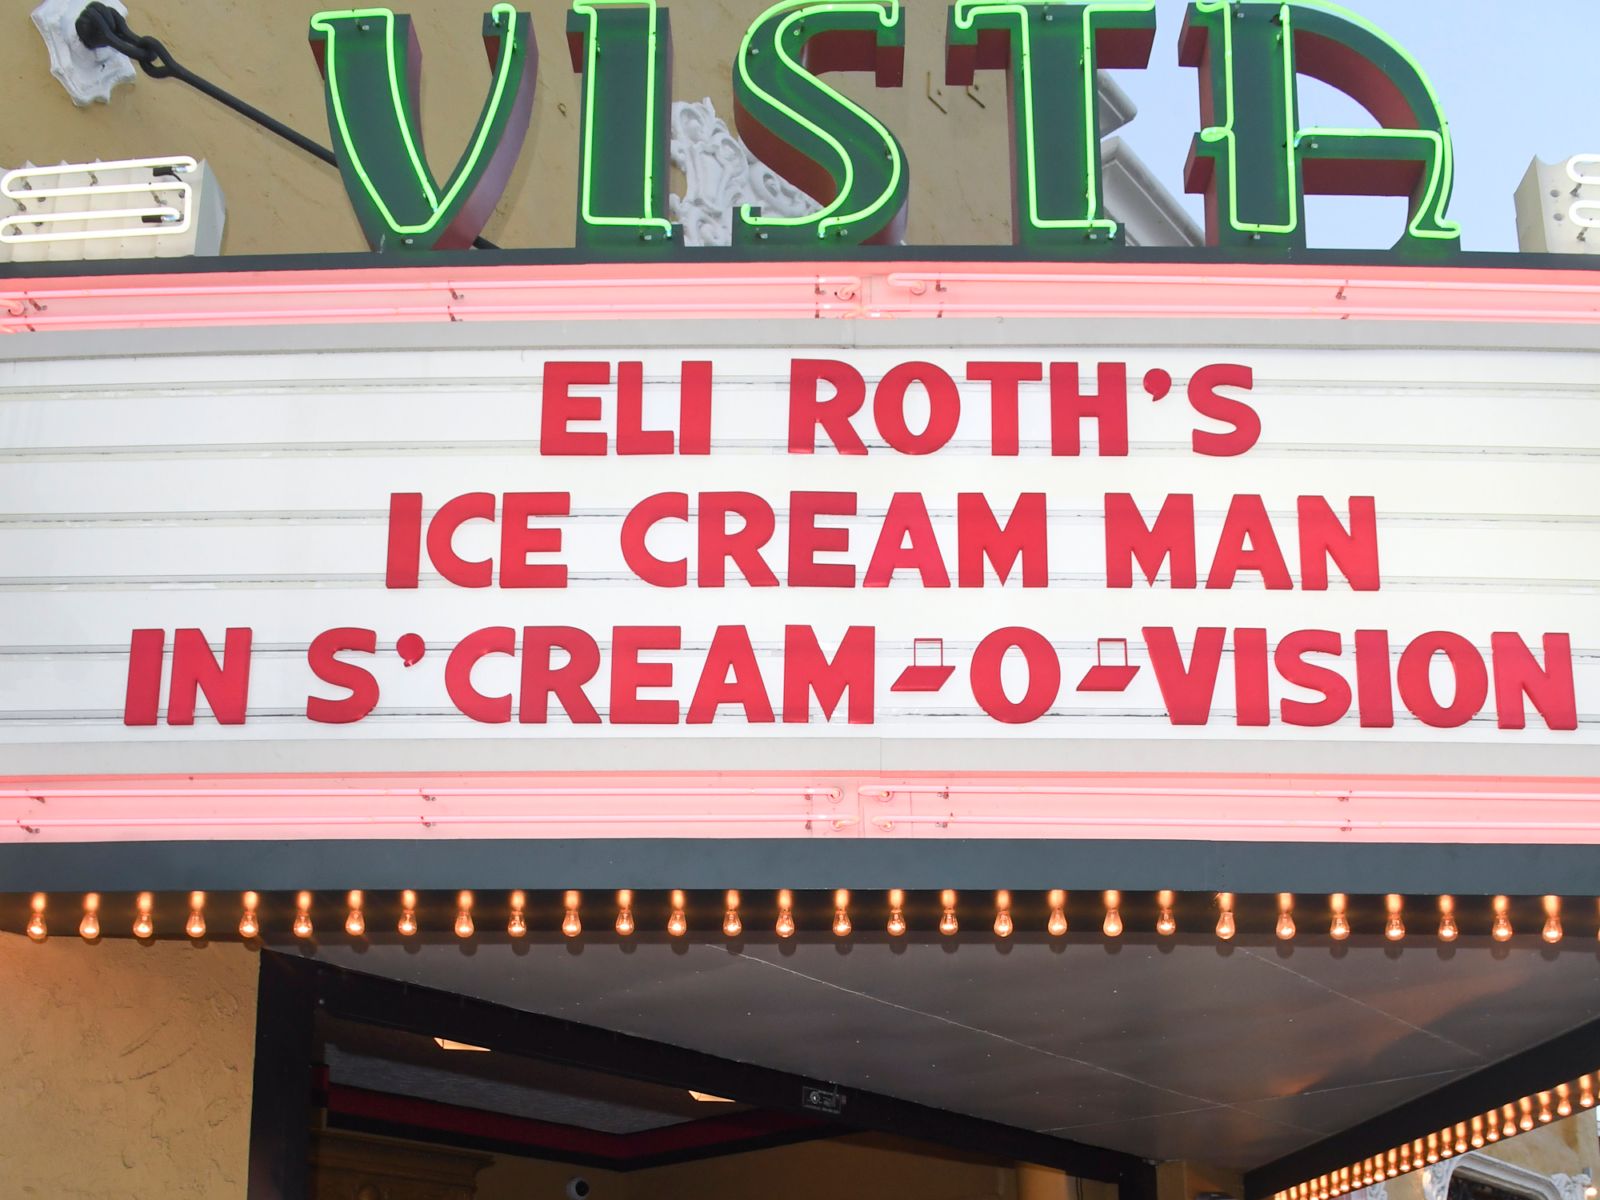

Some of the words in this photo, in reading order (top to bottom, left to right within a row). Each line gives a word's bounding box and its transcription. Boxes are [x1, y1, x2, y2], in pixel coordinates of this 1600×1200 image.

[308, 0, 1460, 250] VISTA
[541, 360, 713, 456] ELI
[788, 359, 1262, 458] ROTH'S
[386, 492, 570, 589] ICE
[620, 491, 1048, 589] CREAM
[1104, 493, 1381, 591] MAN
[124, 627, 252, 726] IN
